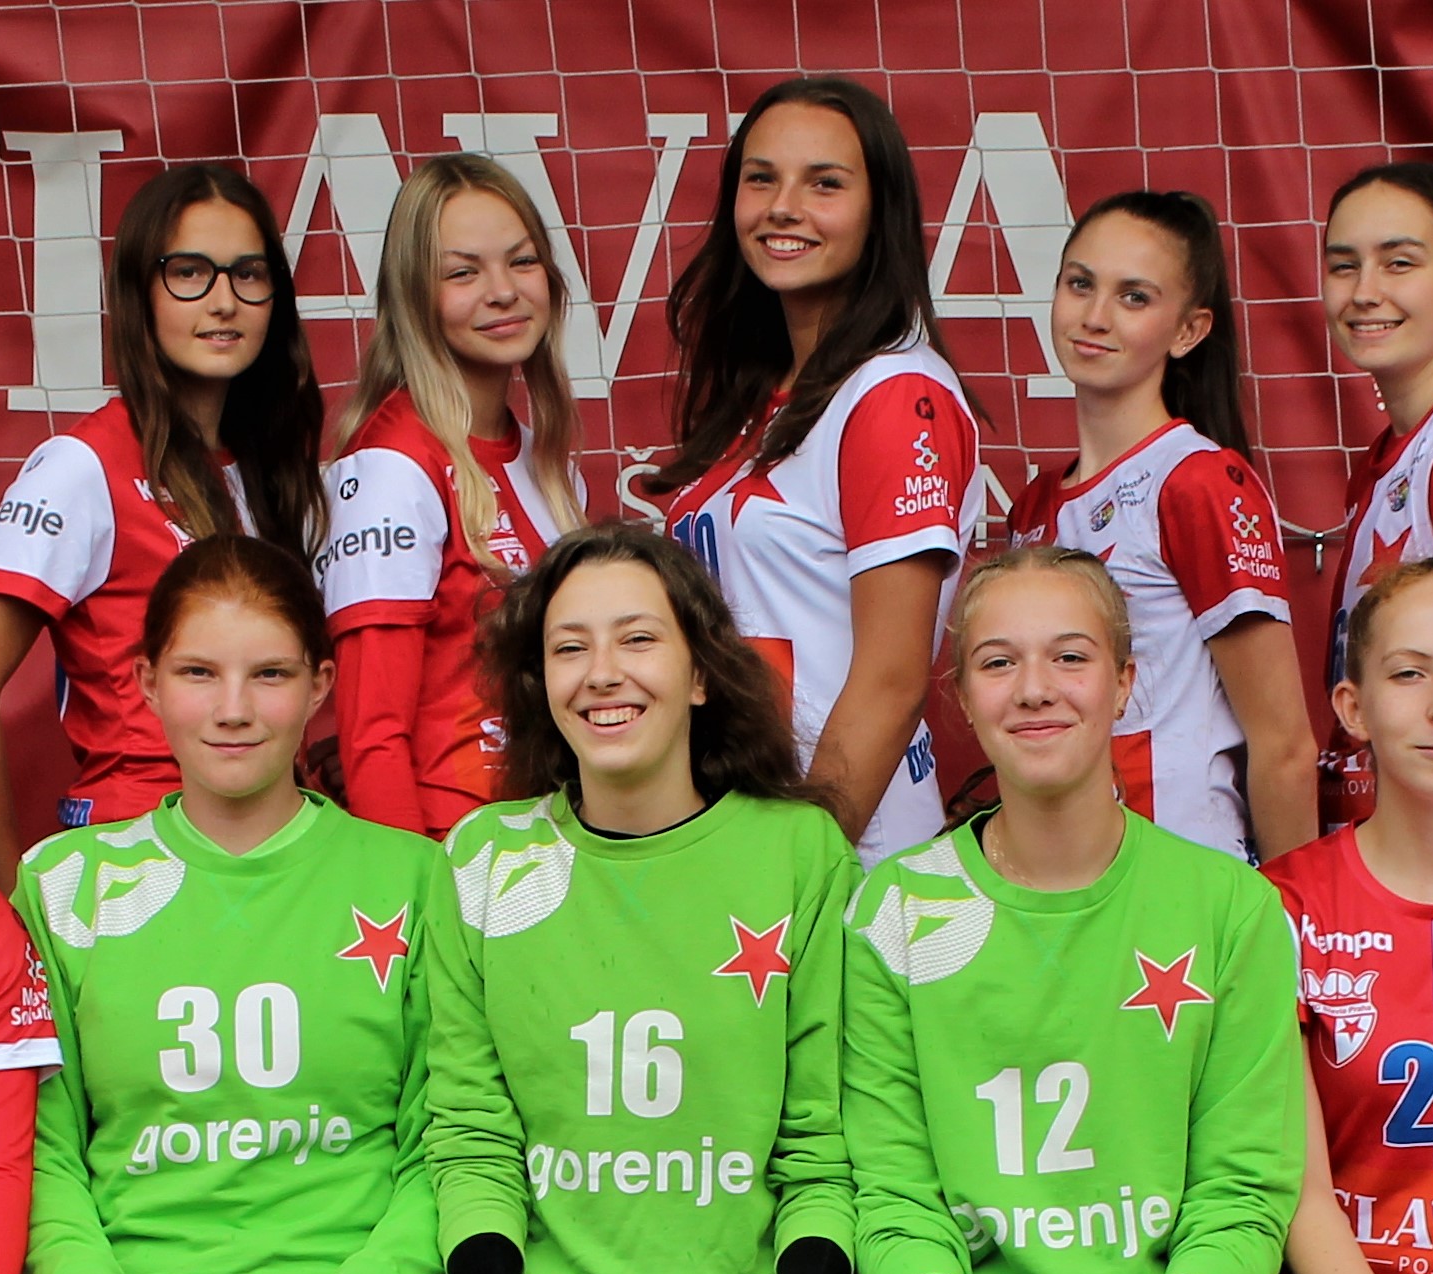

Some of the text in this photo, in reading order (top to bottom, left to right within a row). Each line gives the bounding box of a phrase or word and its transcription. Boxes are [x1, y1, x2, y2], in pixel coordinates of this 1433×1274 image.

[1302, 914, 1393, 959] Kempa
[22, 986, 48, 1007] Mav
[157, 982, 301, 1093] 30
[570, 1009, 684, 1118] 16
[125, 1104, 353, 1176] gorenje
[975, 1061, 1095, 1176] 12
[526, 1136, 754, 1208] gorenje
